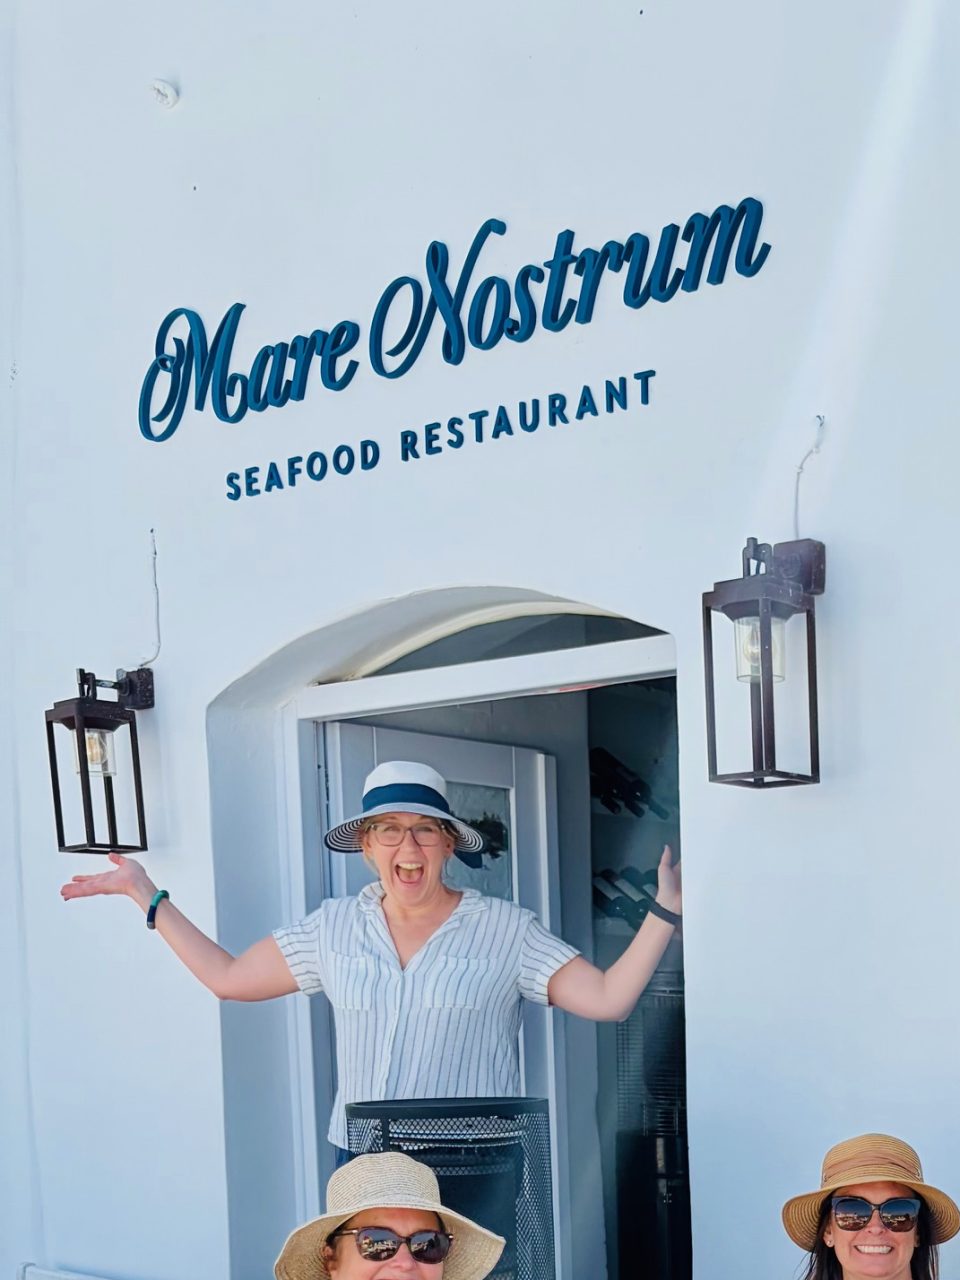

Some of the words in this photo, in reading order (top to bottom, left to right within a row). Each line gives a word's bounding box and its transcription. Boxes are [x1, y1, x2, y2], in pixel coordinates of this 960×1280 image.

[139, 303, 360, 442] Mare
[369, 197, 771, 379] Nostrum
[227, 440, 380, 501] SEAFOOD
[401, 370, 656, 461] RESTAURANT
